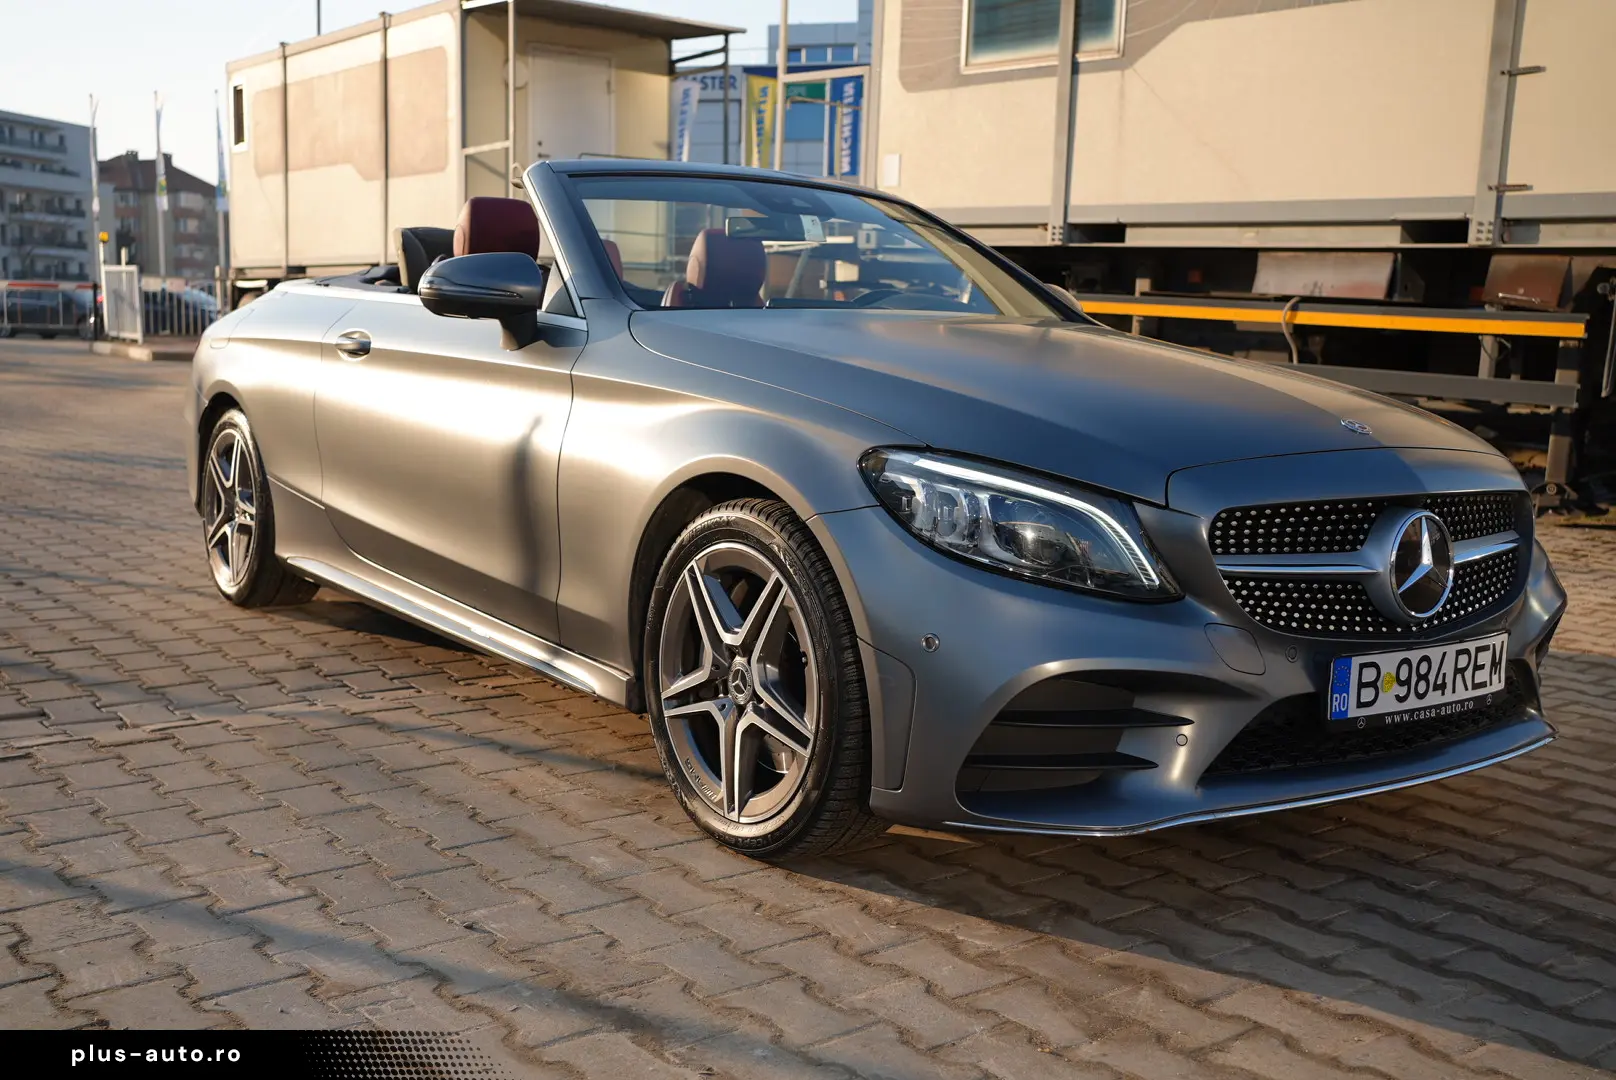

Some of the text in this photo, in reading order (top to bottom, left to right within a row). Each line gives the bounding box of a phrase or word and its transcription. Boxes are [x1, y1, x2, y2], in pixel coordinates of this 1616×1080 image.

[1356, 640, 1504, 709] B 984 REM
[1332, 692, 1348, 712] RO
[1385, 700, 1474, 725] www.casa-auto.ro
